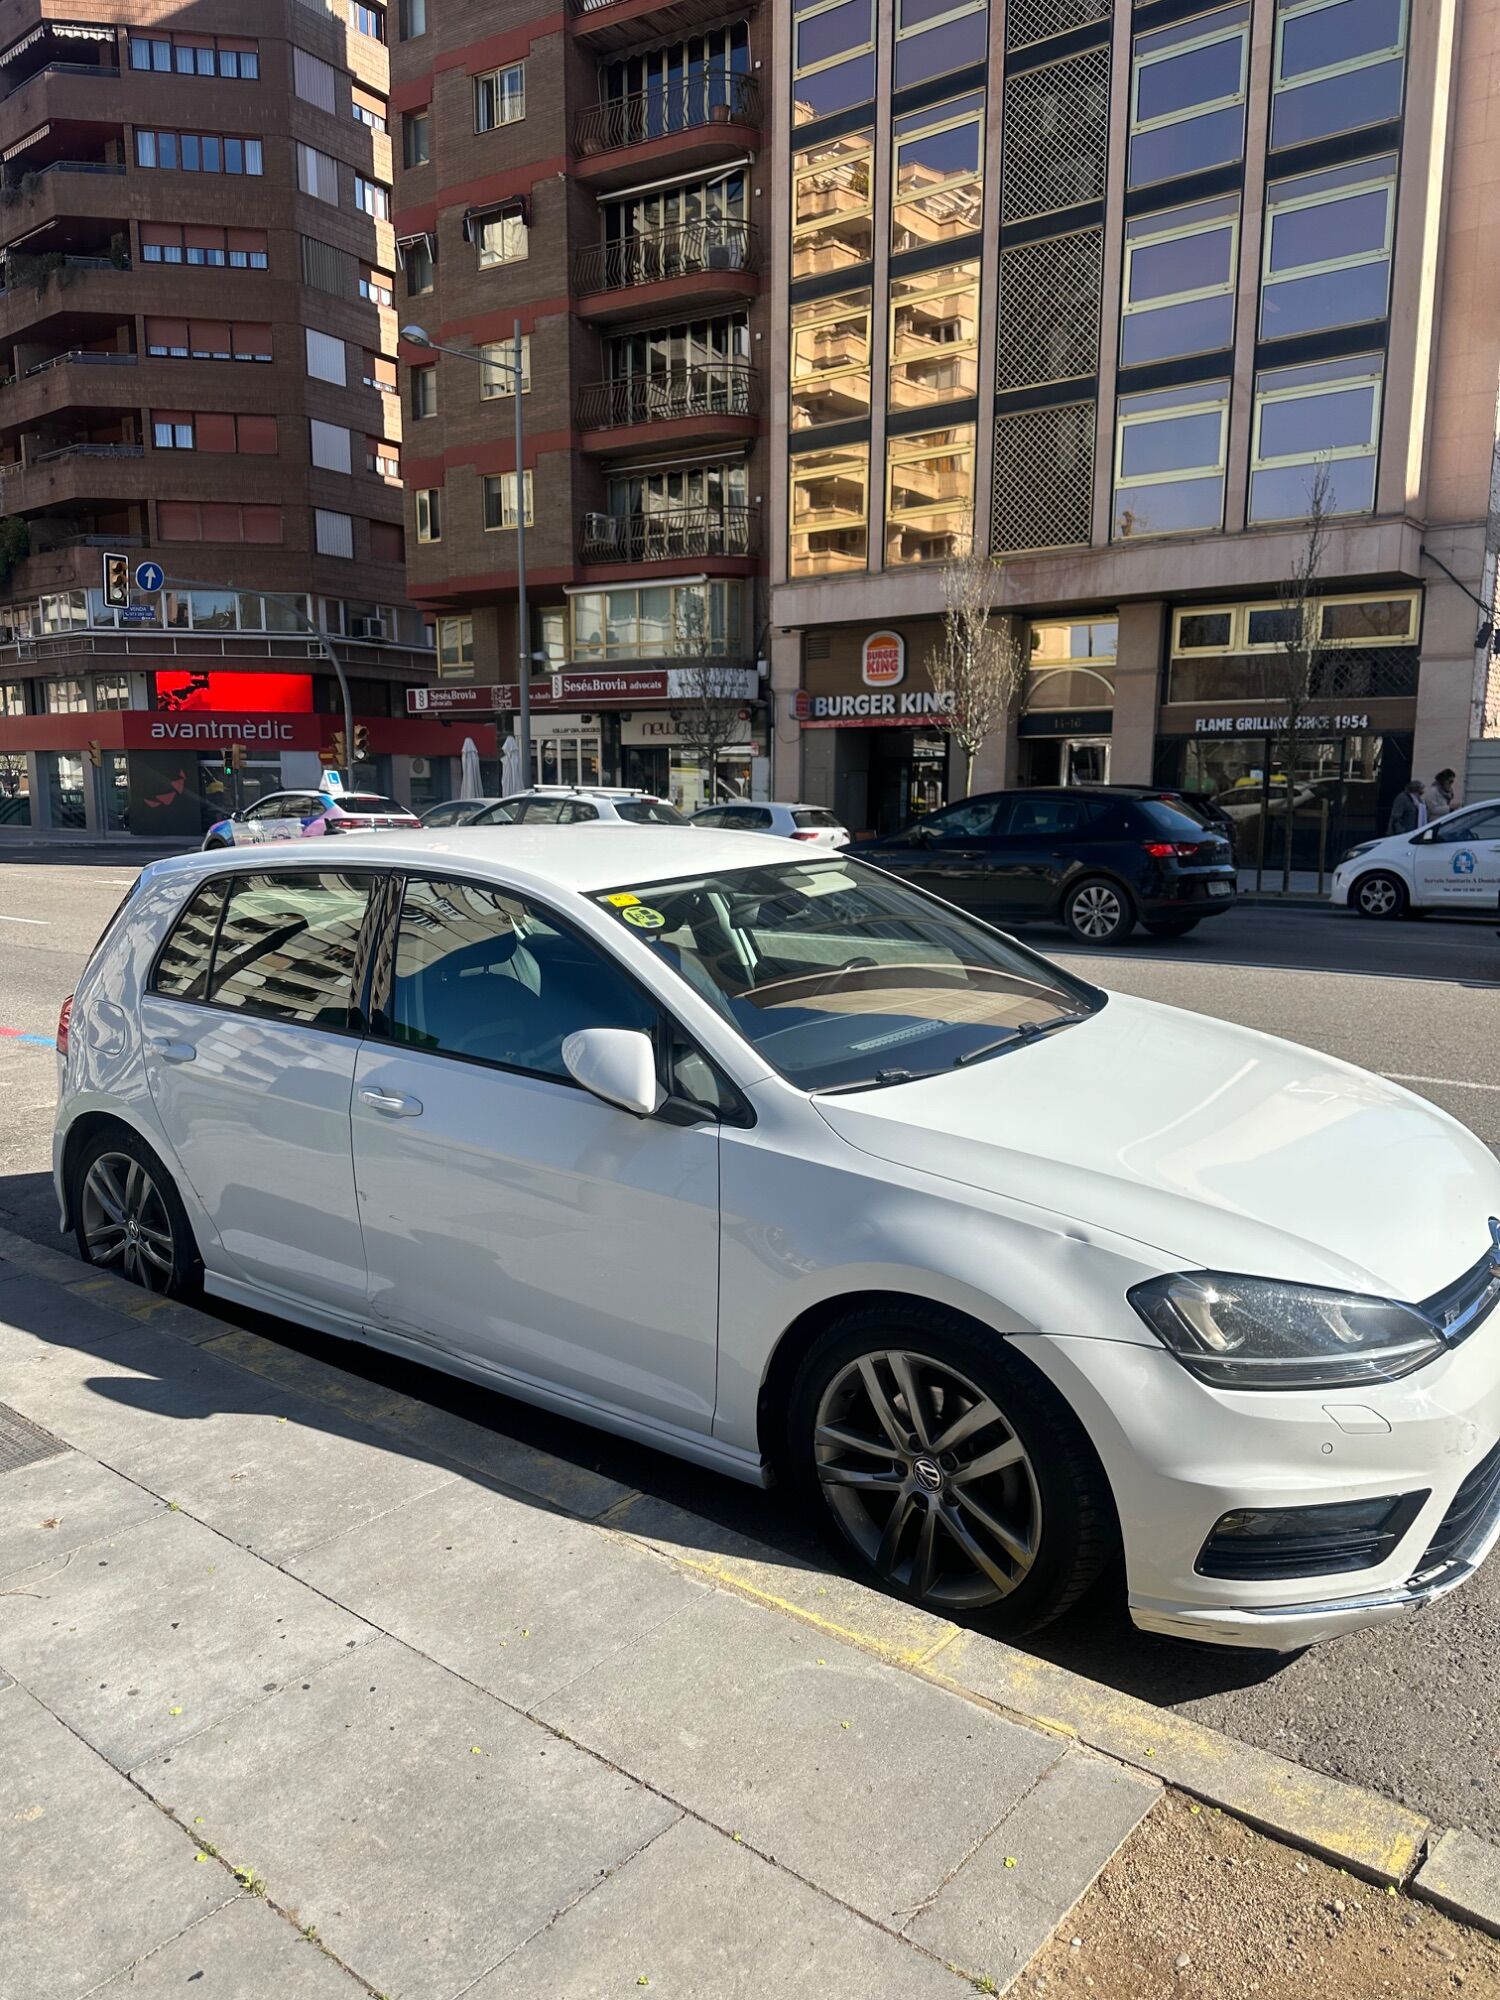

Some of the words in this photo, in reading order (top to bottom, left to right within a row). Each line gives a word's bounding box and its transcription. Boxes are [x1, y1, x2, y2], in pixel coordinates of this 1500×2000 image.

[866, 649, 899, 659] BURGER
[866, 658, 899, 673] KING
[629, 681, 662, 691] advocats
[815, 693, 896, 717] BURGER
[901, 691, 956, 715] KING
[151, 719, 295, 740] avantmèdic
[1196, 718, 1233, 732] FLAME
[1334, 714, 1368, 729] 1954
